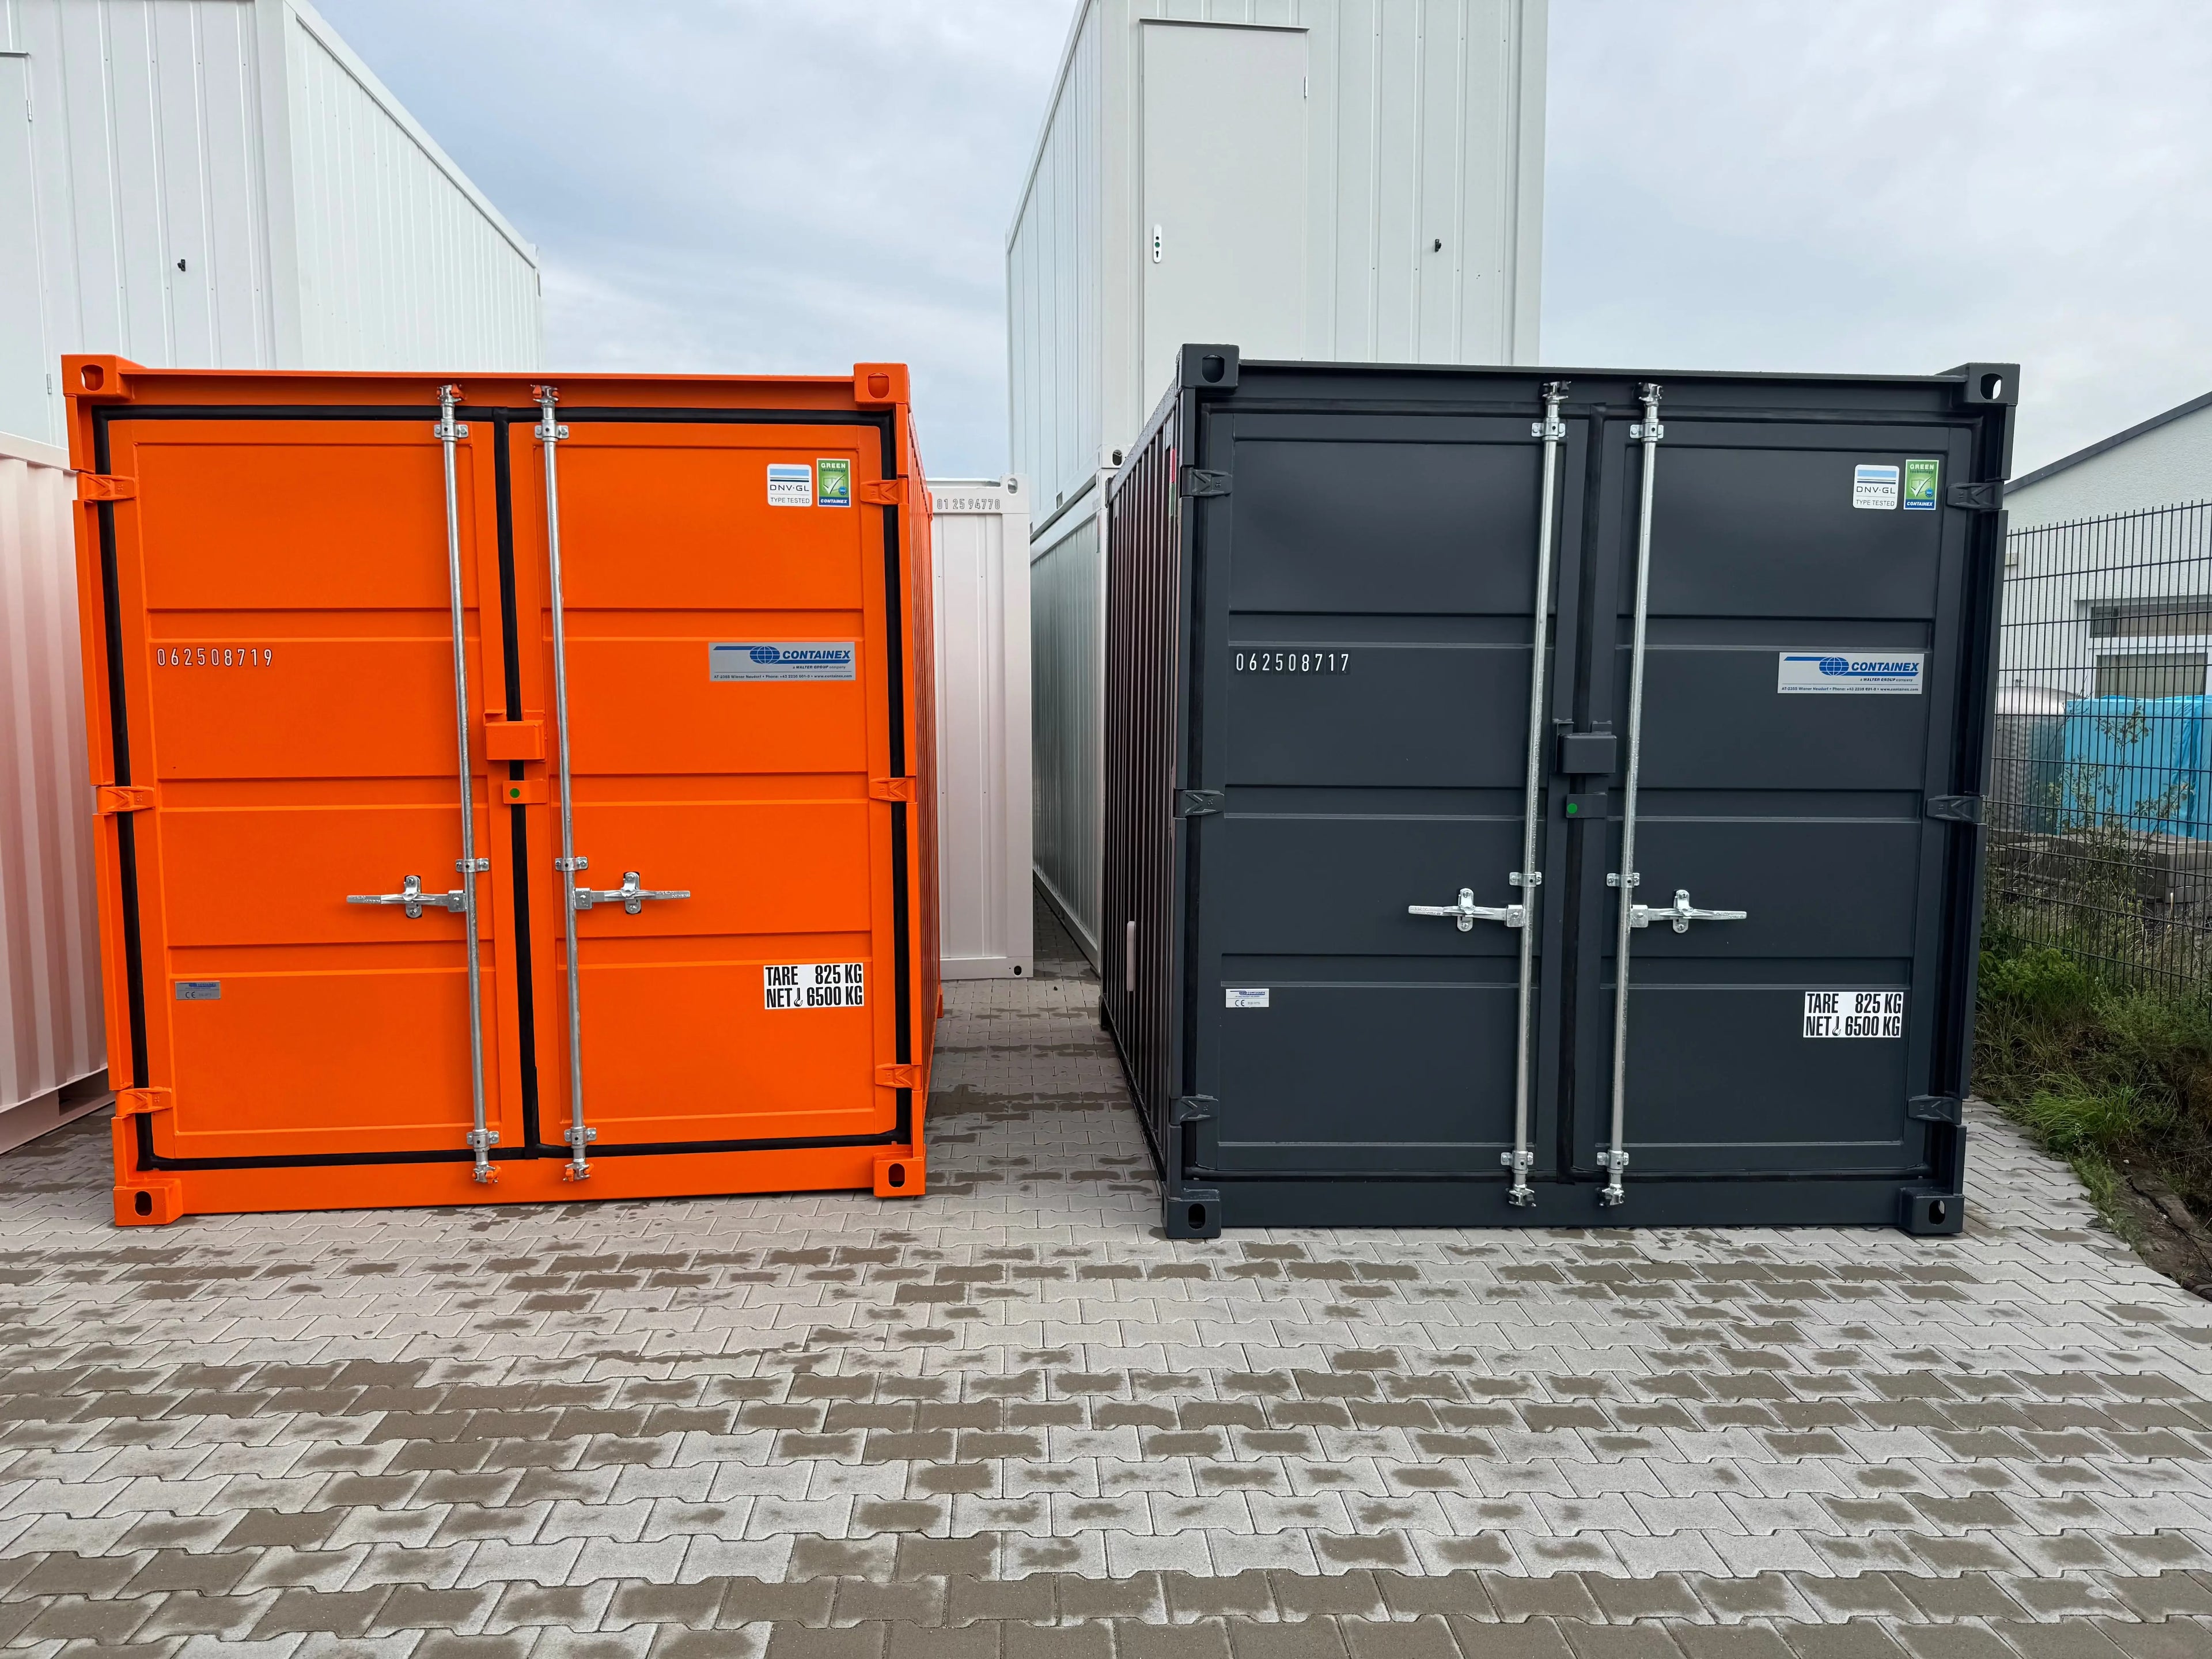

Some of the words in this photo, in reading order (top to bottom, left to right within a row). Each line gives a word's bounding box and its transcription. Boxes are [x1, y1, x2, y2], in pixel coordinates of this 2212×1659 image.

[156, 647, 273, 667] 062508719
[782, 650, 851, 659] CONTAINEX
[1236, 653, 1349, 672] 062508717
[1851, 662, 1919, 671] CONTAINEX
[765, 966, 798, 986] TARE
[815, 965, 841, 984] 825
[844, 964, 862, 984] KG
[766, 988, 793, 1008] NET
[806, 986, 842, 1006] 6500
[845, 986, 863, 1005] KG
[1807, 993, 1839, 1013] TARE
[1855, 993, 1881, 1014] 825
[1884, 993, 1902, 1014] KG
[1805, 1016, 1832, 1036] NET
[1844, 1016, 1880, 1036] 6500
[1883, 1016, 1900, 1036] KG
